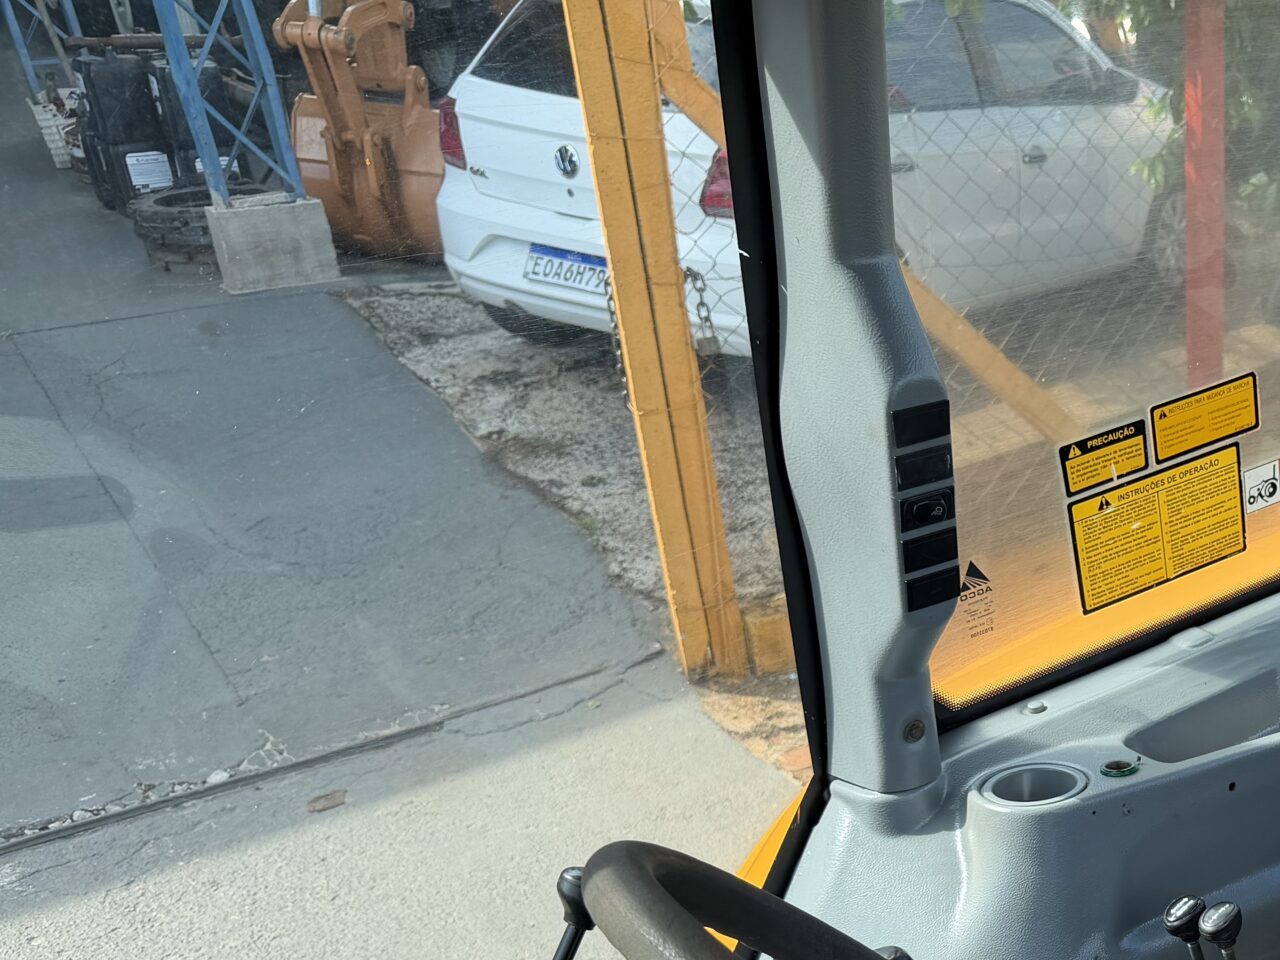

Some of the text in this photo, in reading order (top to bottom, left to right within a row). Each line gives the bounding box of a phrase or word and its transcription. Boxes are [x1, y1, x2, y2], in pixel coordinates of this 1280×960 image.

[1087, 426, 1135, 449] PRECAUÇÃO
[1117, 458, 1220, 502] INSTRUÇÕES DE OPERAÇÃO
